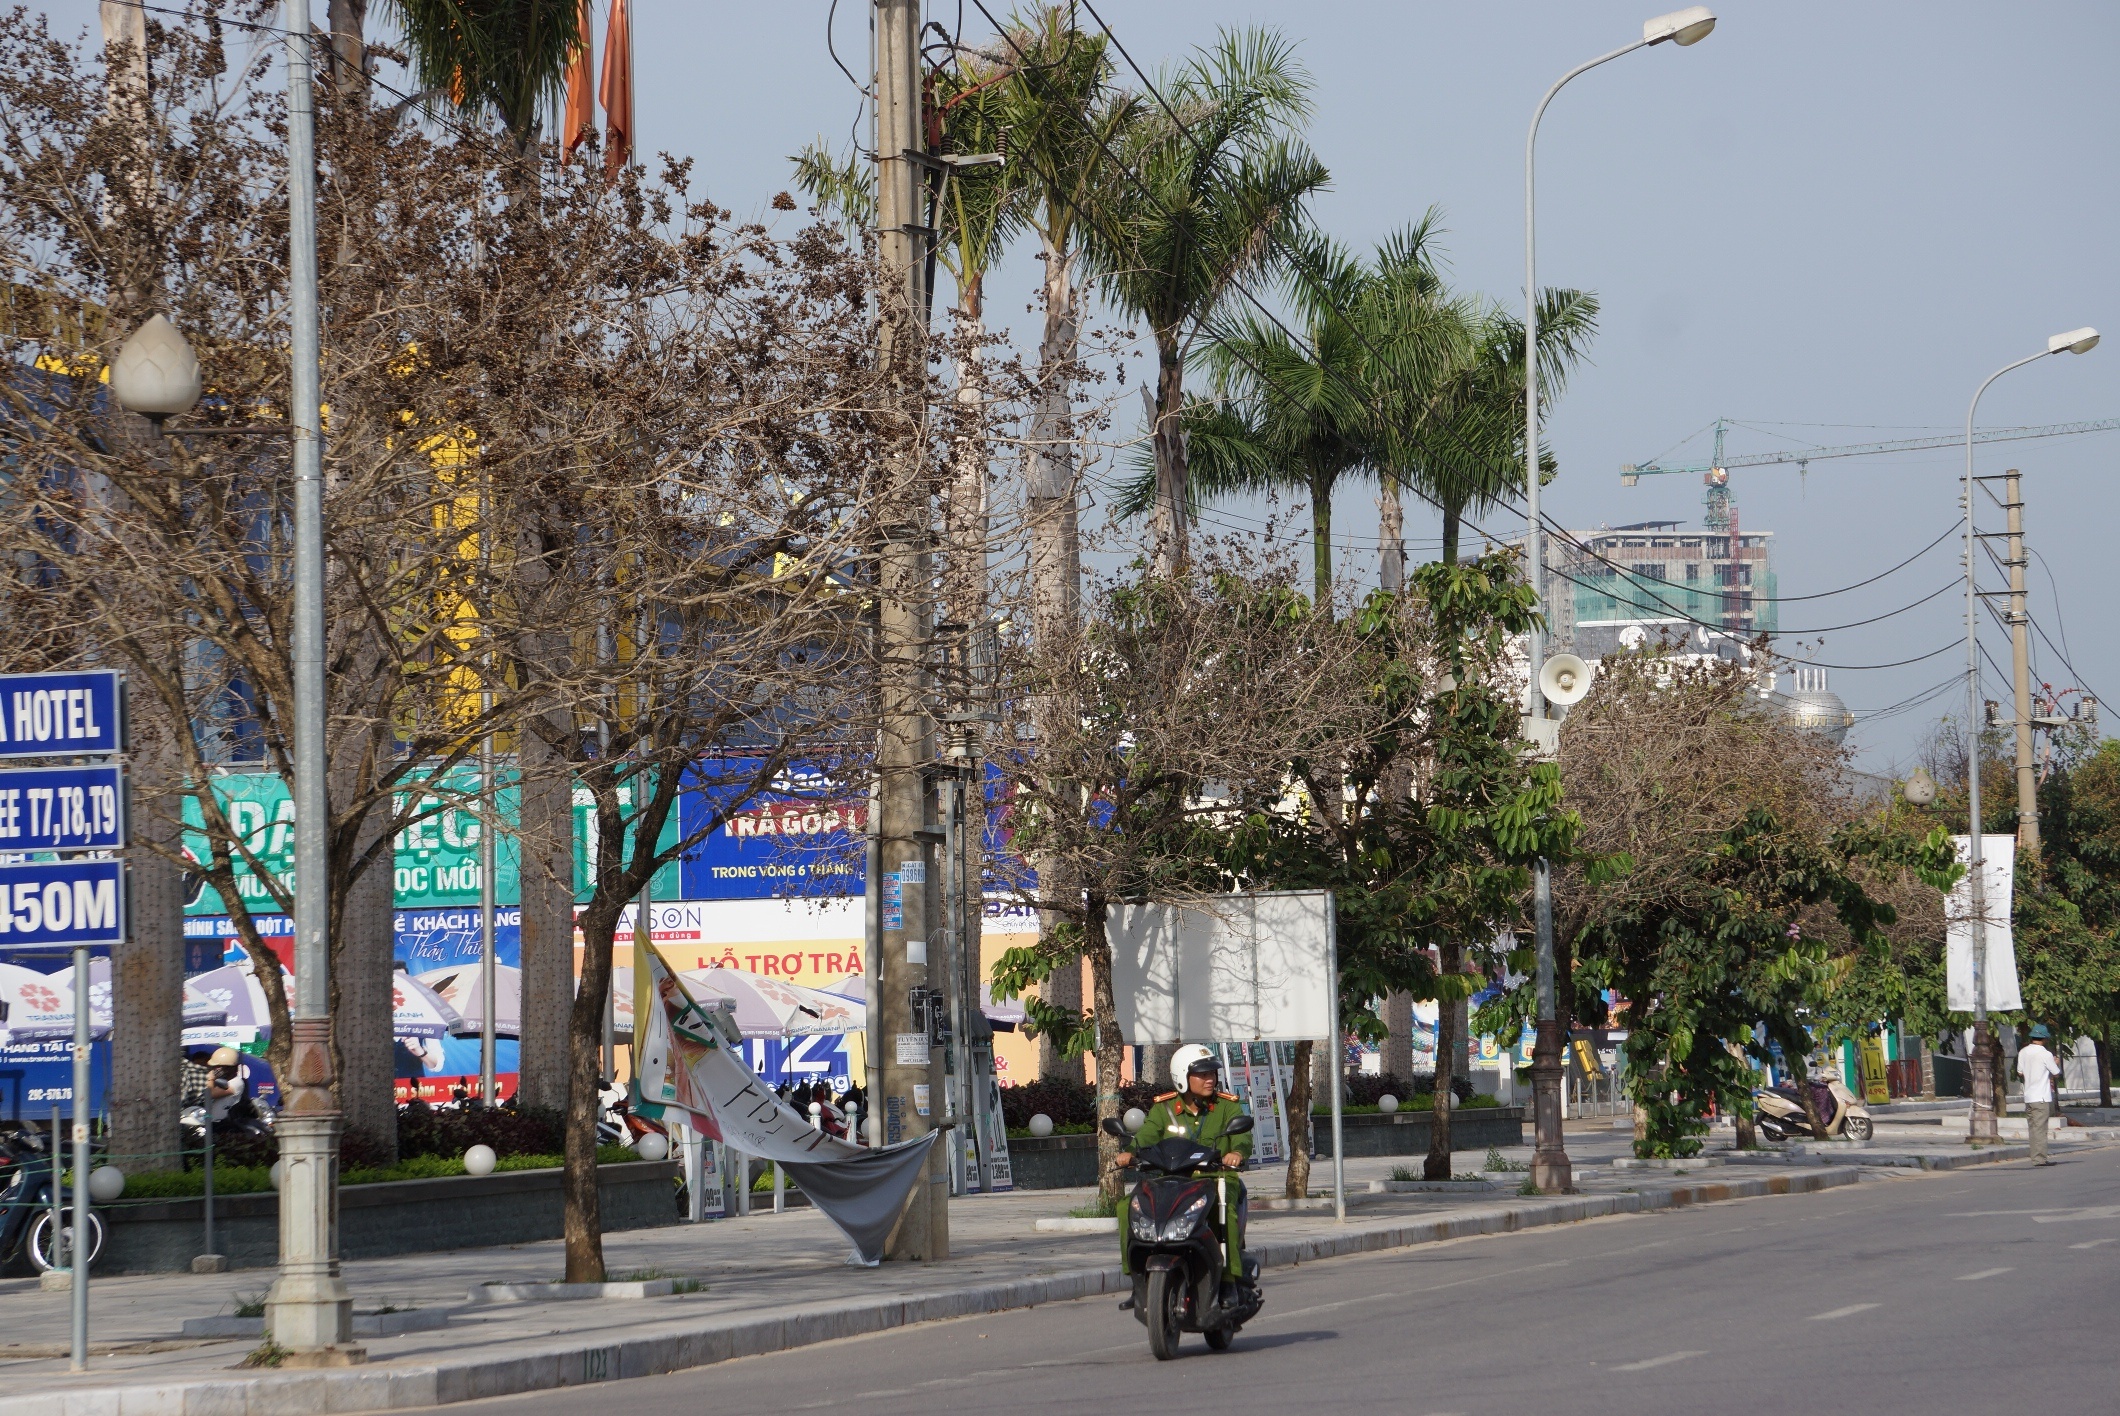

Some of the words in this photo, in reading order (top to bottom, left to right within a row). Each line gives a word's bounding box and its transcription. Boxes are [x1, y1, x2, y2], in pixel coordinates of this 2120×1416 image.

[13, 689, 100, 741] HOTEL
[27, 785, 116, 845] T7,T8,T9
[711, 866, 756, 878] TRONG
[758, 863, 795, 877] VÒNG
[798, 865, 806, 876] 6
[256, 917, 282, 936] ĐỘT
[413, 912, 468, 931] KHÁCH
[473, 912, 521, 929] HNG
[745, 951, 804, 981] TRỢ
[808, 946, 863, 974] TRẢ
